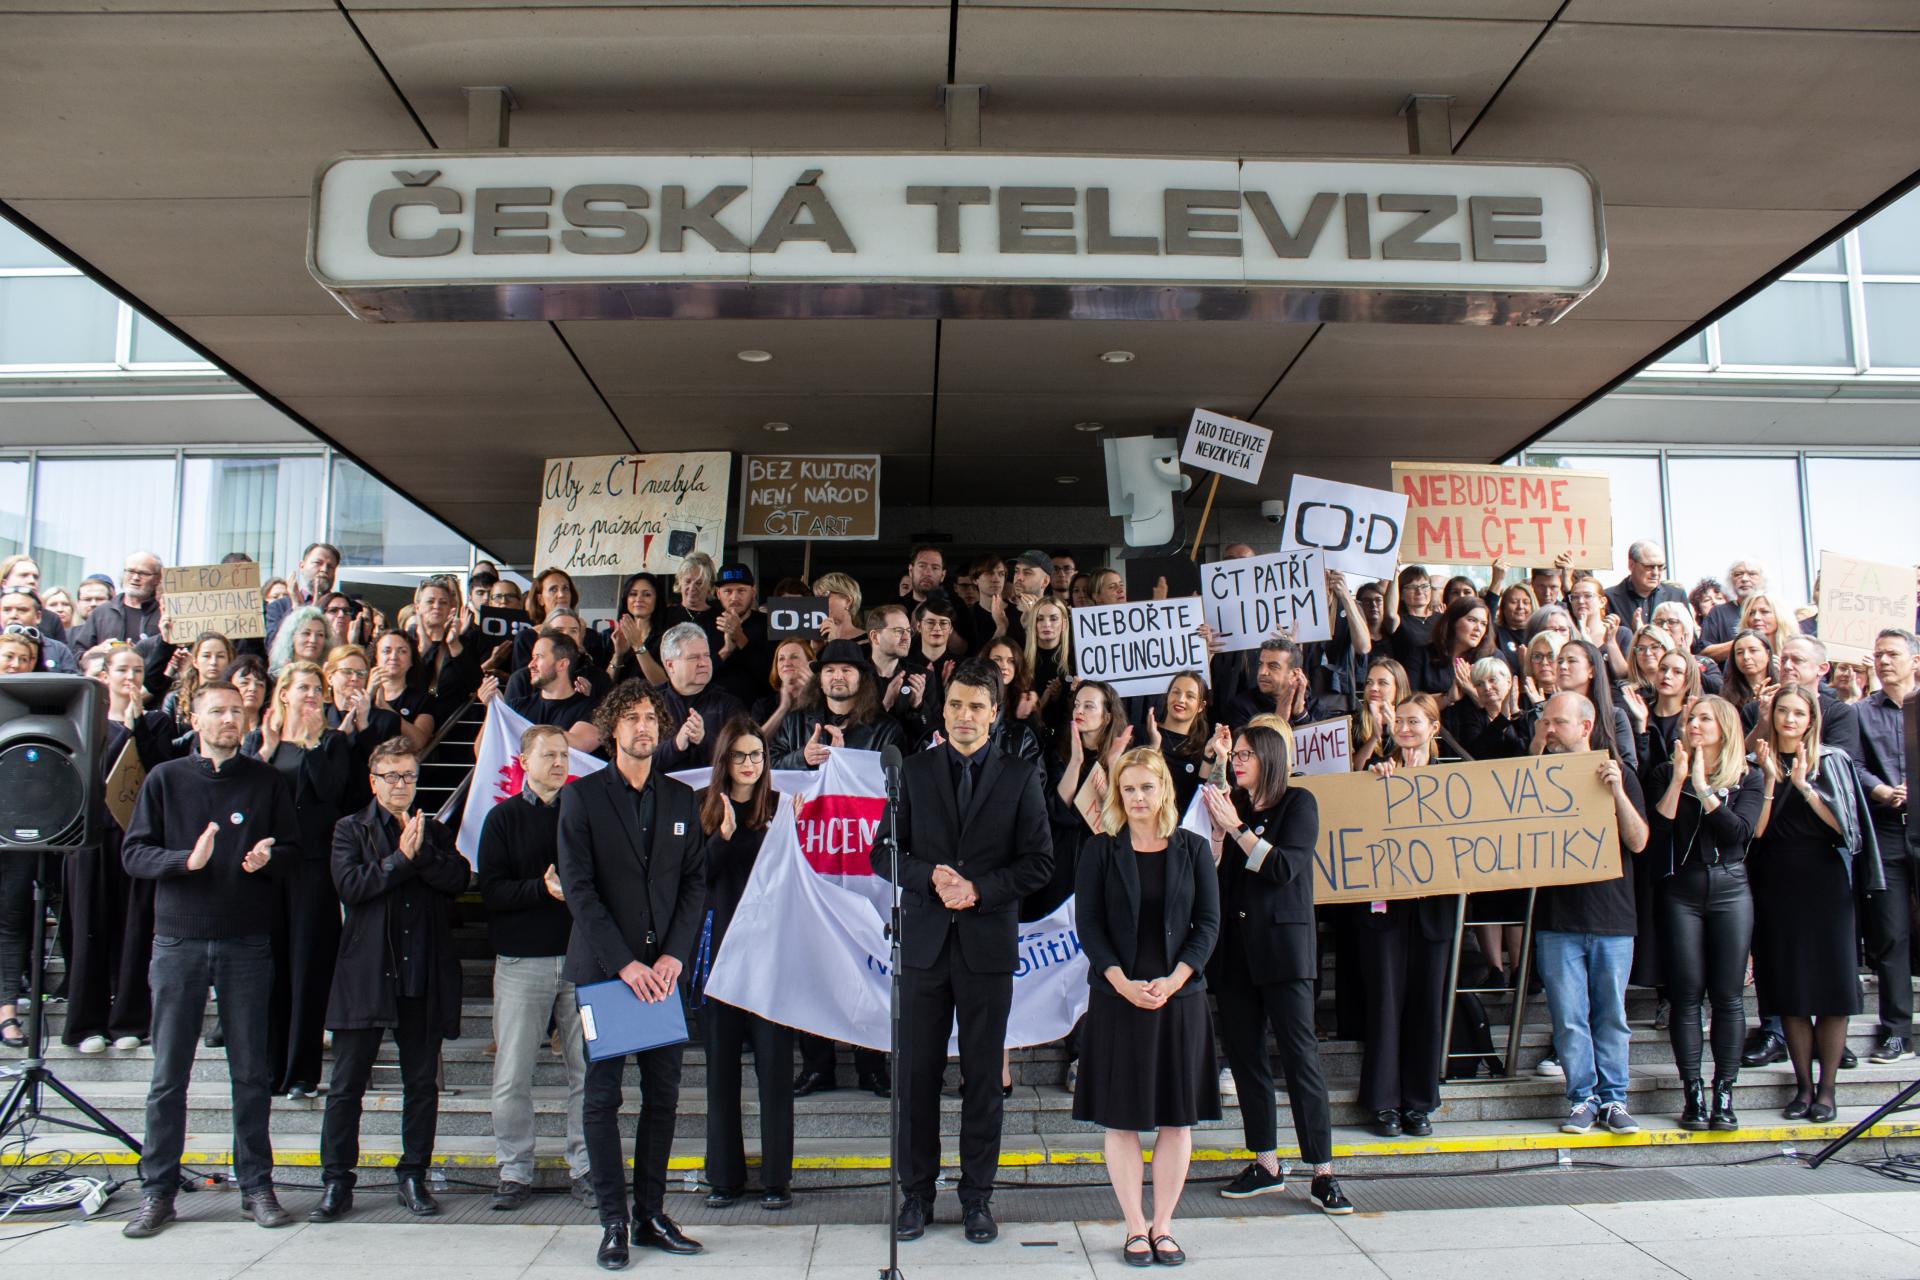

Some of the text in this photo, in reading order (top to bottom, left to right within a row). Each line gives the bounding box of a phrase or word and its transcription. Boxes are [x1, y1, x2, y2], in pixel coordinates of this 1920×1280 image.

[367, 168, 1547, 263] ČESKÁ TELEVIZE
[1195, 419, 1265, 453] TATO TELEVIZE
[749, 460, 878, 482] BEZ KULTURY
[1195, 441, 1254, 470] NEVZKVÉTÁ
[545, 456, 710, 512] Aby z ČT nezbyla
[750, 481, 869, 506] NENÍ NÁROD
[1403, 474, 1570, 512] NEBUDEME
[549, 519, 586, 554] jen
[764, 505, 853, 536] ČT ART
[565, 538, 622, 570] bedna
[199, 568, 221, 588] PO
[232, 564, 253, 587] ČT
[1211, 553, 1314, 600] ČT PATŘÍ
[1827, 588, 1908, 618] PESTRÉ
[224, 615, 258, 636] DÍRA
[1080, 603, 1192, 638] NEBOŘTE
[1081, 633, 1203, 675] CO FUNGUJE
[1376, 772, 1472, 825] PRO
